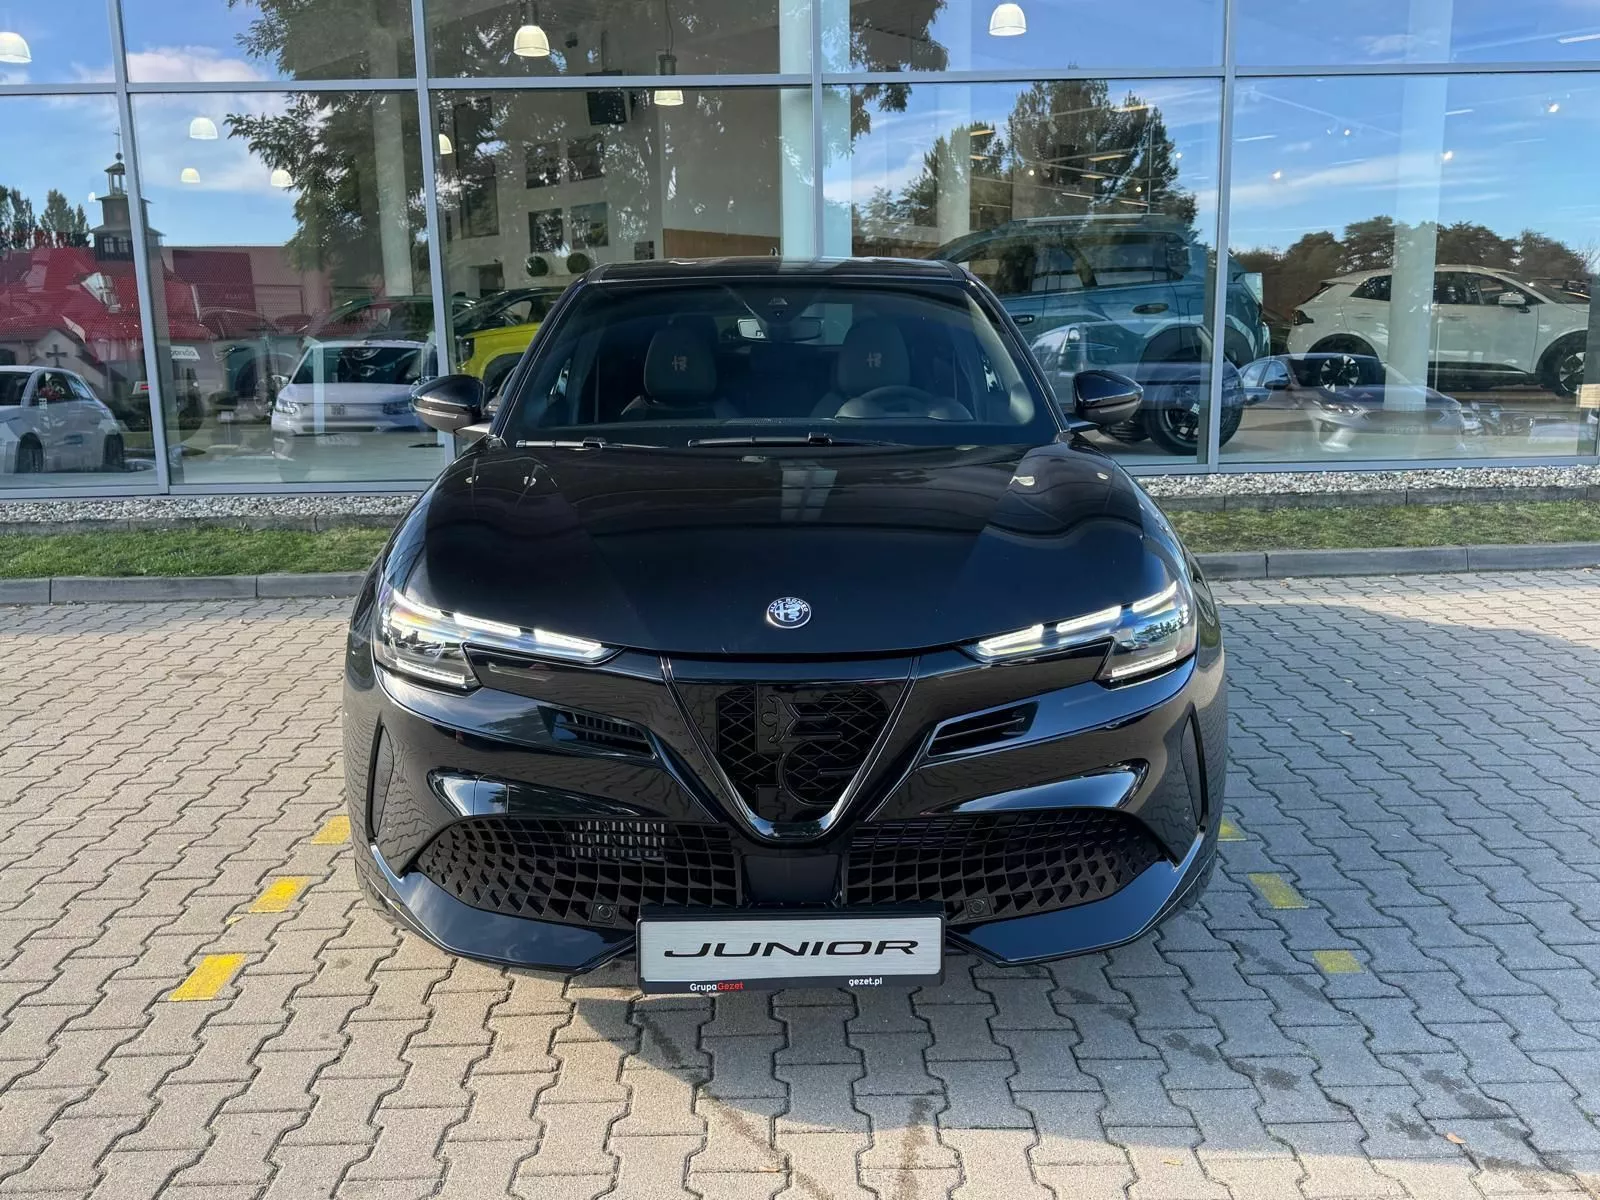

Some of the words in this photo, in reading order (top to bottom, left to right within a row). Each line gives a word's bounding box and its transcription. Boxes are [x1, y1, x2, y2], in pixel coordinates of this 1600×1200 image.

[664, 940, 918, 957] JUNIOR
[690, 981, 745, 992] GrupaGezet
[848, 977, 883, 987] gezet.pl
